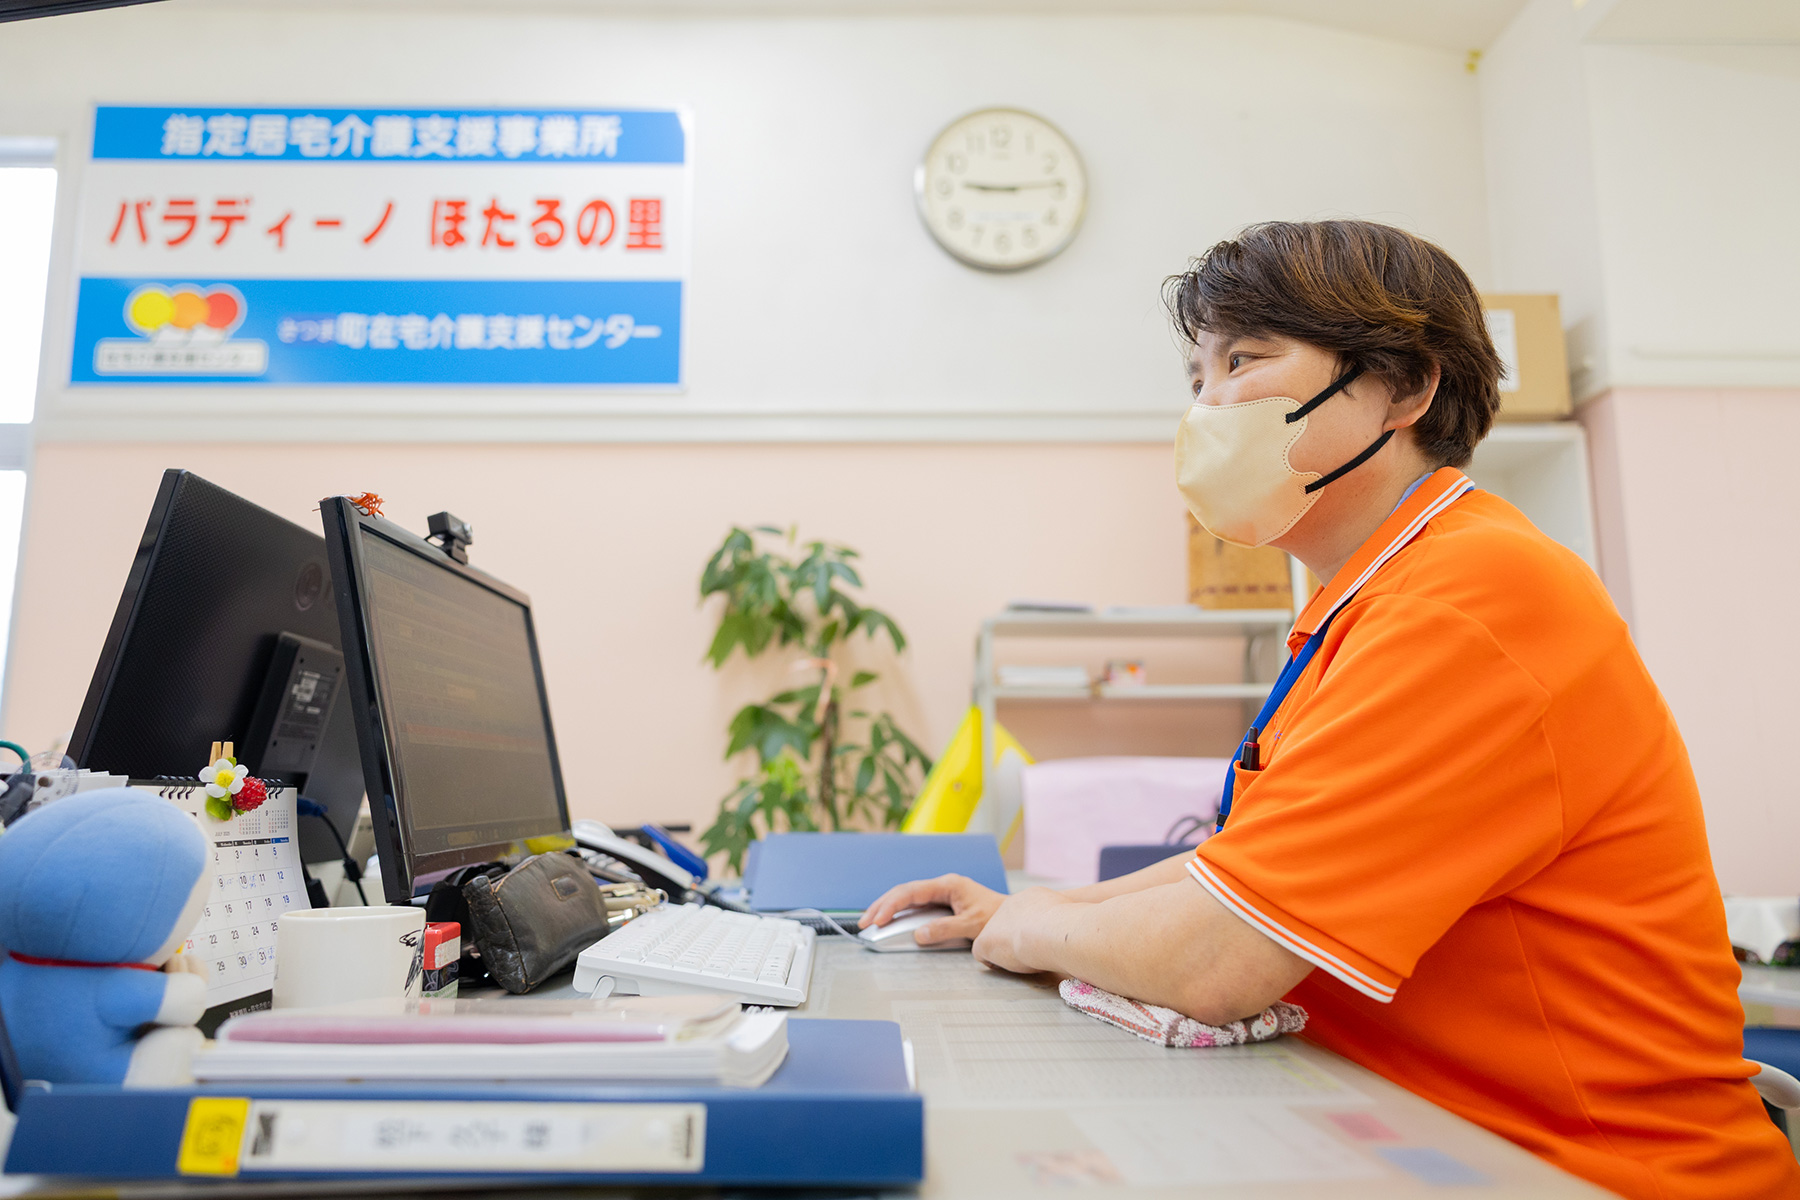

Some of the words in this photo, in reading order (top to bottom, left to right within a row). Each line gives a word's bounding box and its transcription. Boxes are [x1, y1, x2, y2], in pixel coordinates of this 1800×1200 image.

[161, 113, 623, 158] 指定居宅介護支援事業所
[431, 199, 663, 248] ほたるの里
[235, 850, 240, 859] 3
[255, 848, 259, 857] 4
[273, 847, 277, 856] 5
[219, 878, 224, 888] 9
[240, 875, 248, 885] 10
[259, 874, 266, 882] 11
[277, 871, 284, 880] 12
[225, 904, 233, 914] 16
[245, 900, 253, 910] 17
[264, 897, 272, 907] 18
[282, 894, 290, 904] 19
[186, 939, 194, 950] 21
[209, 934, 218, 945] 22
[231, 930, 240, 940] 23
[251, 926, 259, 936] 24
[271, 922, 278, 932] 25
[217, 961, 226, 971] 29
[239, 956, 248, 966] 30
[259, 952, 267, 961] 31
